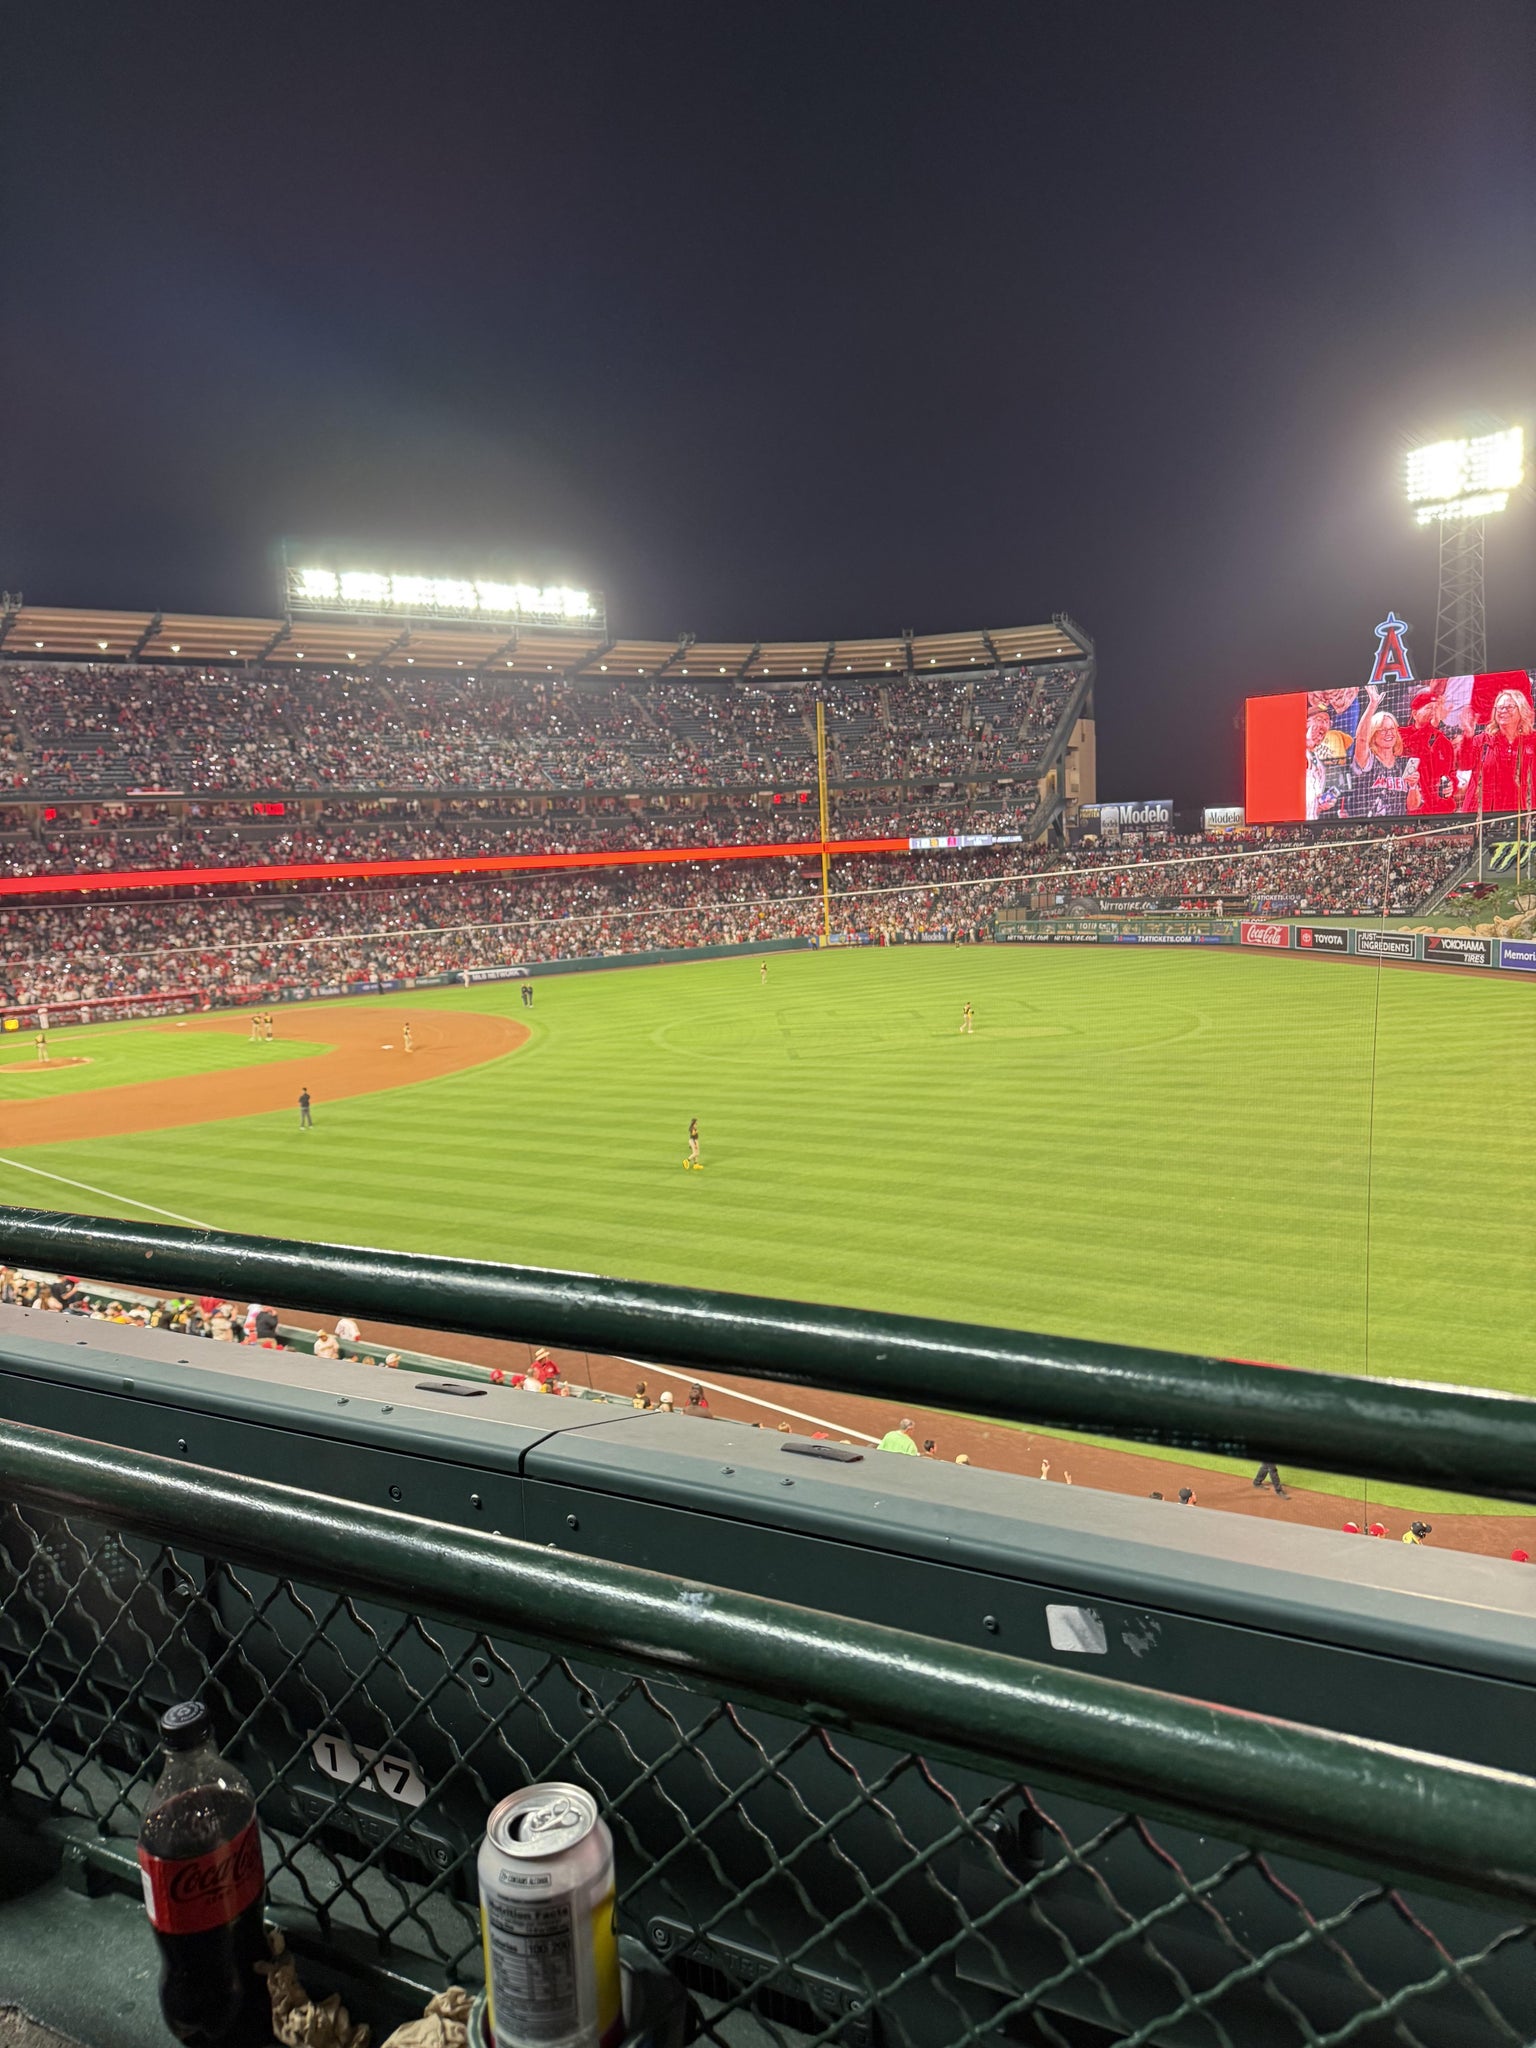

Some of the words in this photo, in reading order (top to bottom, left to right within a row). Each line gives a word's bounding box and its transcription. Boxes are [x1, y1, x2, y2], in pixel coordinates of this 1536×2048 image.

[1368, 612, 1414, 684] A
[1120, 804, 1169, 825] Modelo
[1210, 811, 1240, 824] Modelo
[921, 932, 945, 942] Modelo
[1137, 935, 1192, 943] 714TICKETS.COM
[1314, 934, 1343, 945] TOYOTA
[1361, 933, 1377, 941] JUST
[1361, 941, 1410, 953] INGREDIENTS
[1464, 953, 1485, 964] TIRES
[1504, 949, 1536, 961] Memori
